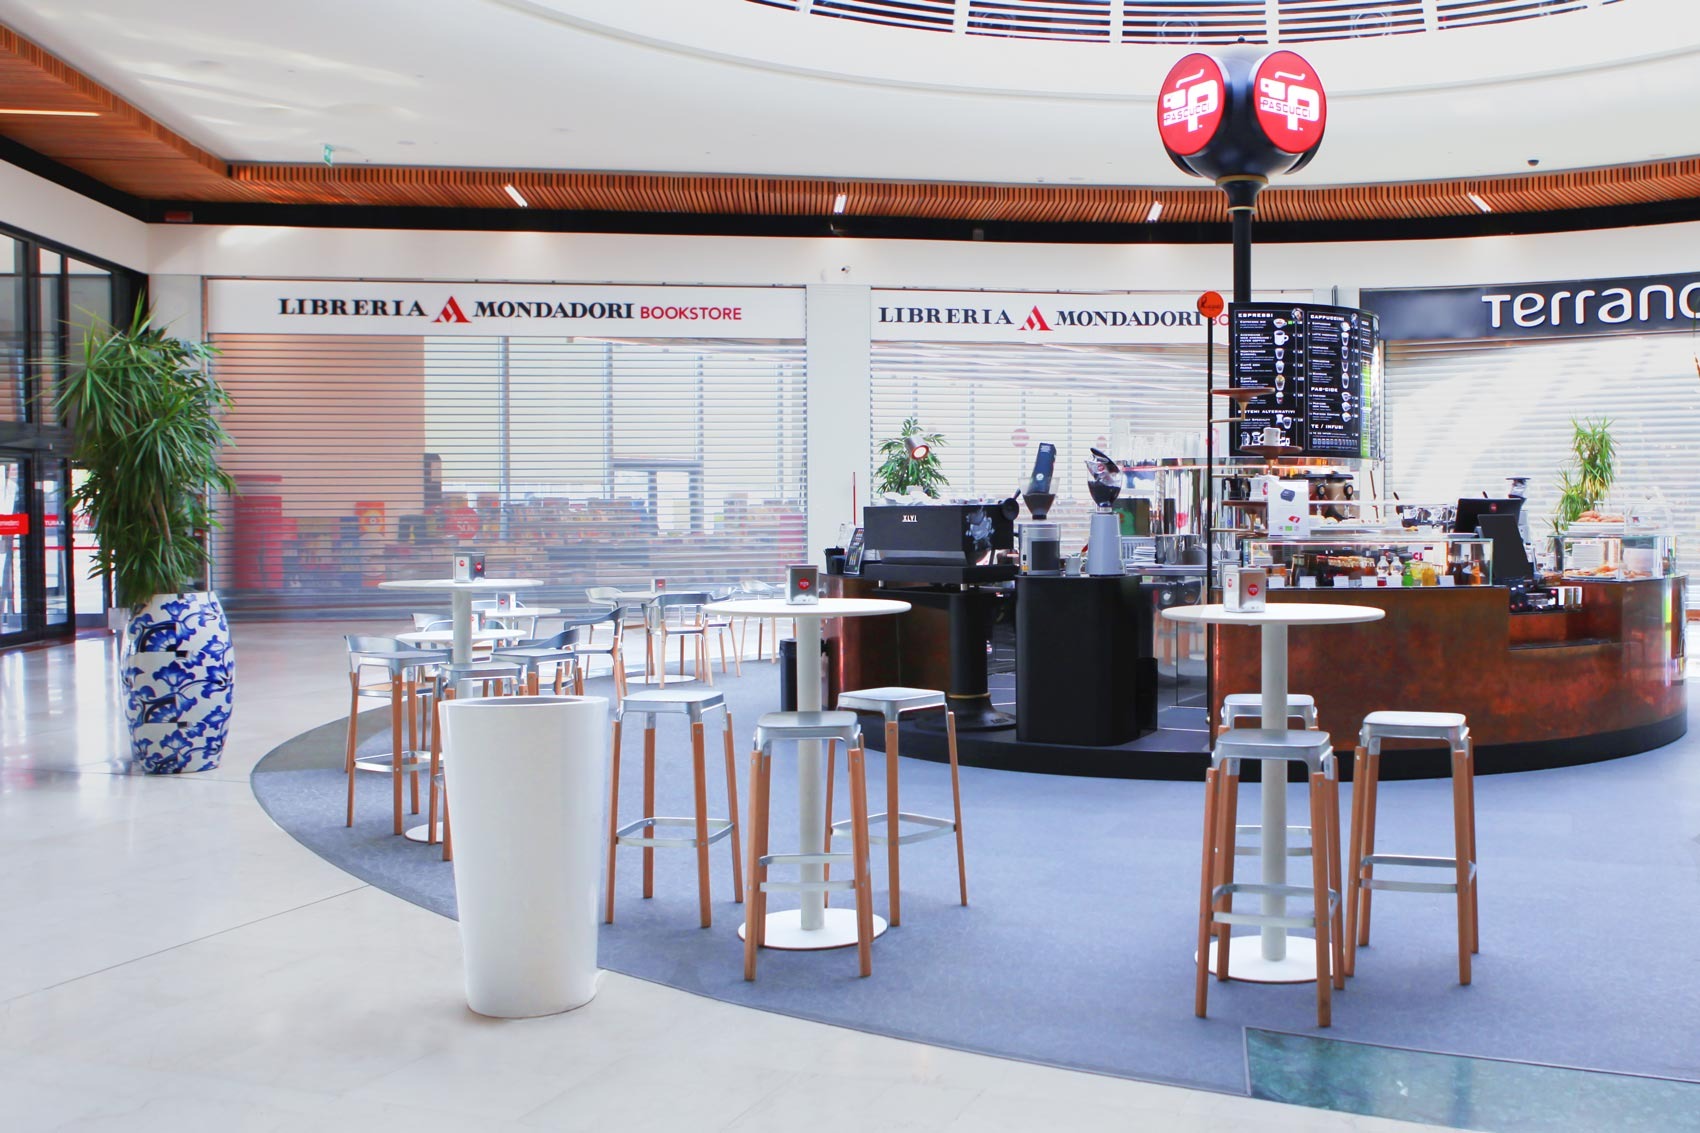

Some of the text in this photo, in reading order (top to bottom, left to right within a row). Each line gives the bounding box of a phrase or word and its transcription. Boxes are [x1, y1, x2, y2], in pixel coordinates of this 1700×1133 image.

[1164, 102, 1210, 122] PASCUCCI
[1260, 99, 1311, 118] PASCUCCI
[278, 298, 742, 320] LIBRERIA MONDADORI BOOKSTORE
[878, 306, 1015, 325] LIBRERIA
[1054, 310, 1203, 327] MONDADORI
